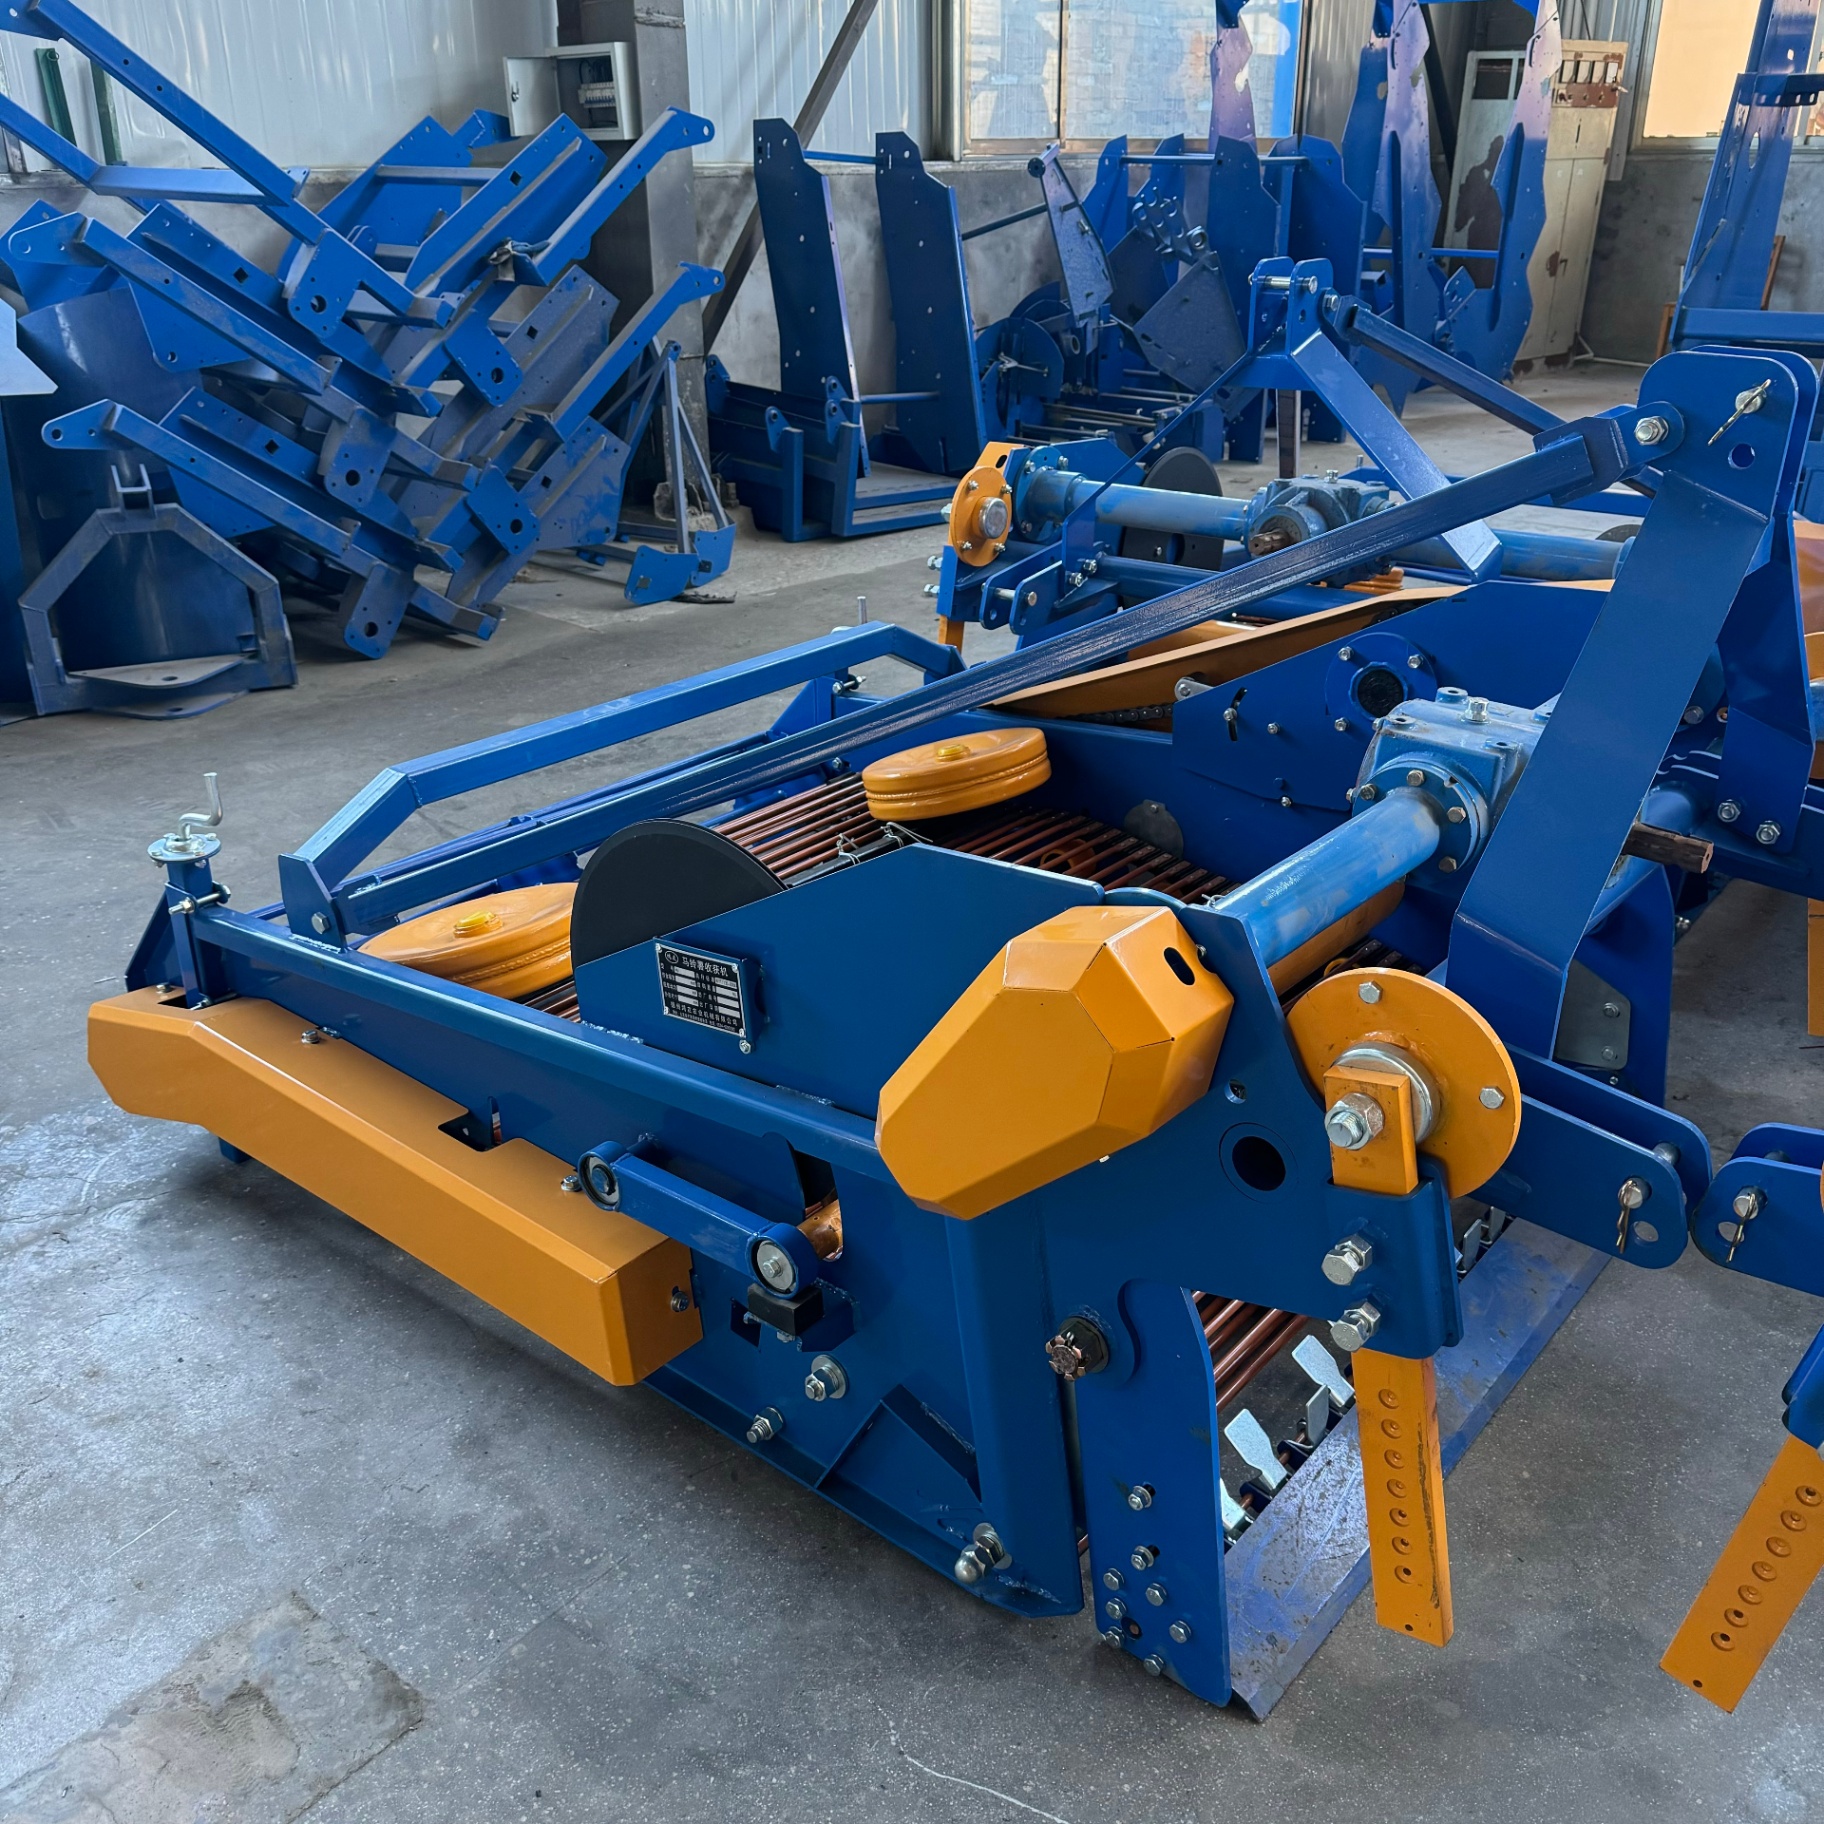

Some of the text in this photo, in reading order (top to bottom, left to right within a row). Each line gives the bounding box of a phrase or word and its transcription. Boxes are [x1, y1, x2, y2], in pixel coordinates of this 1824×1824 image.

[681, 956, 729, 977] 马铃薯收获机
